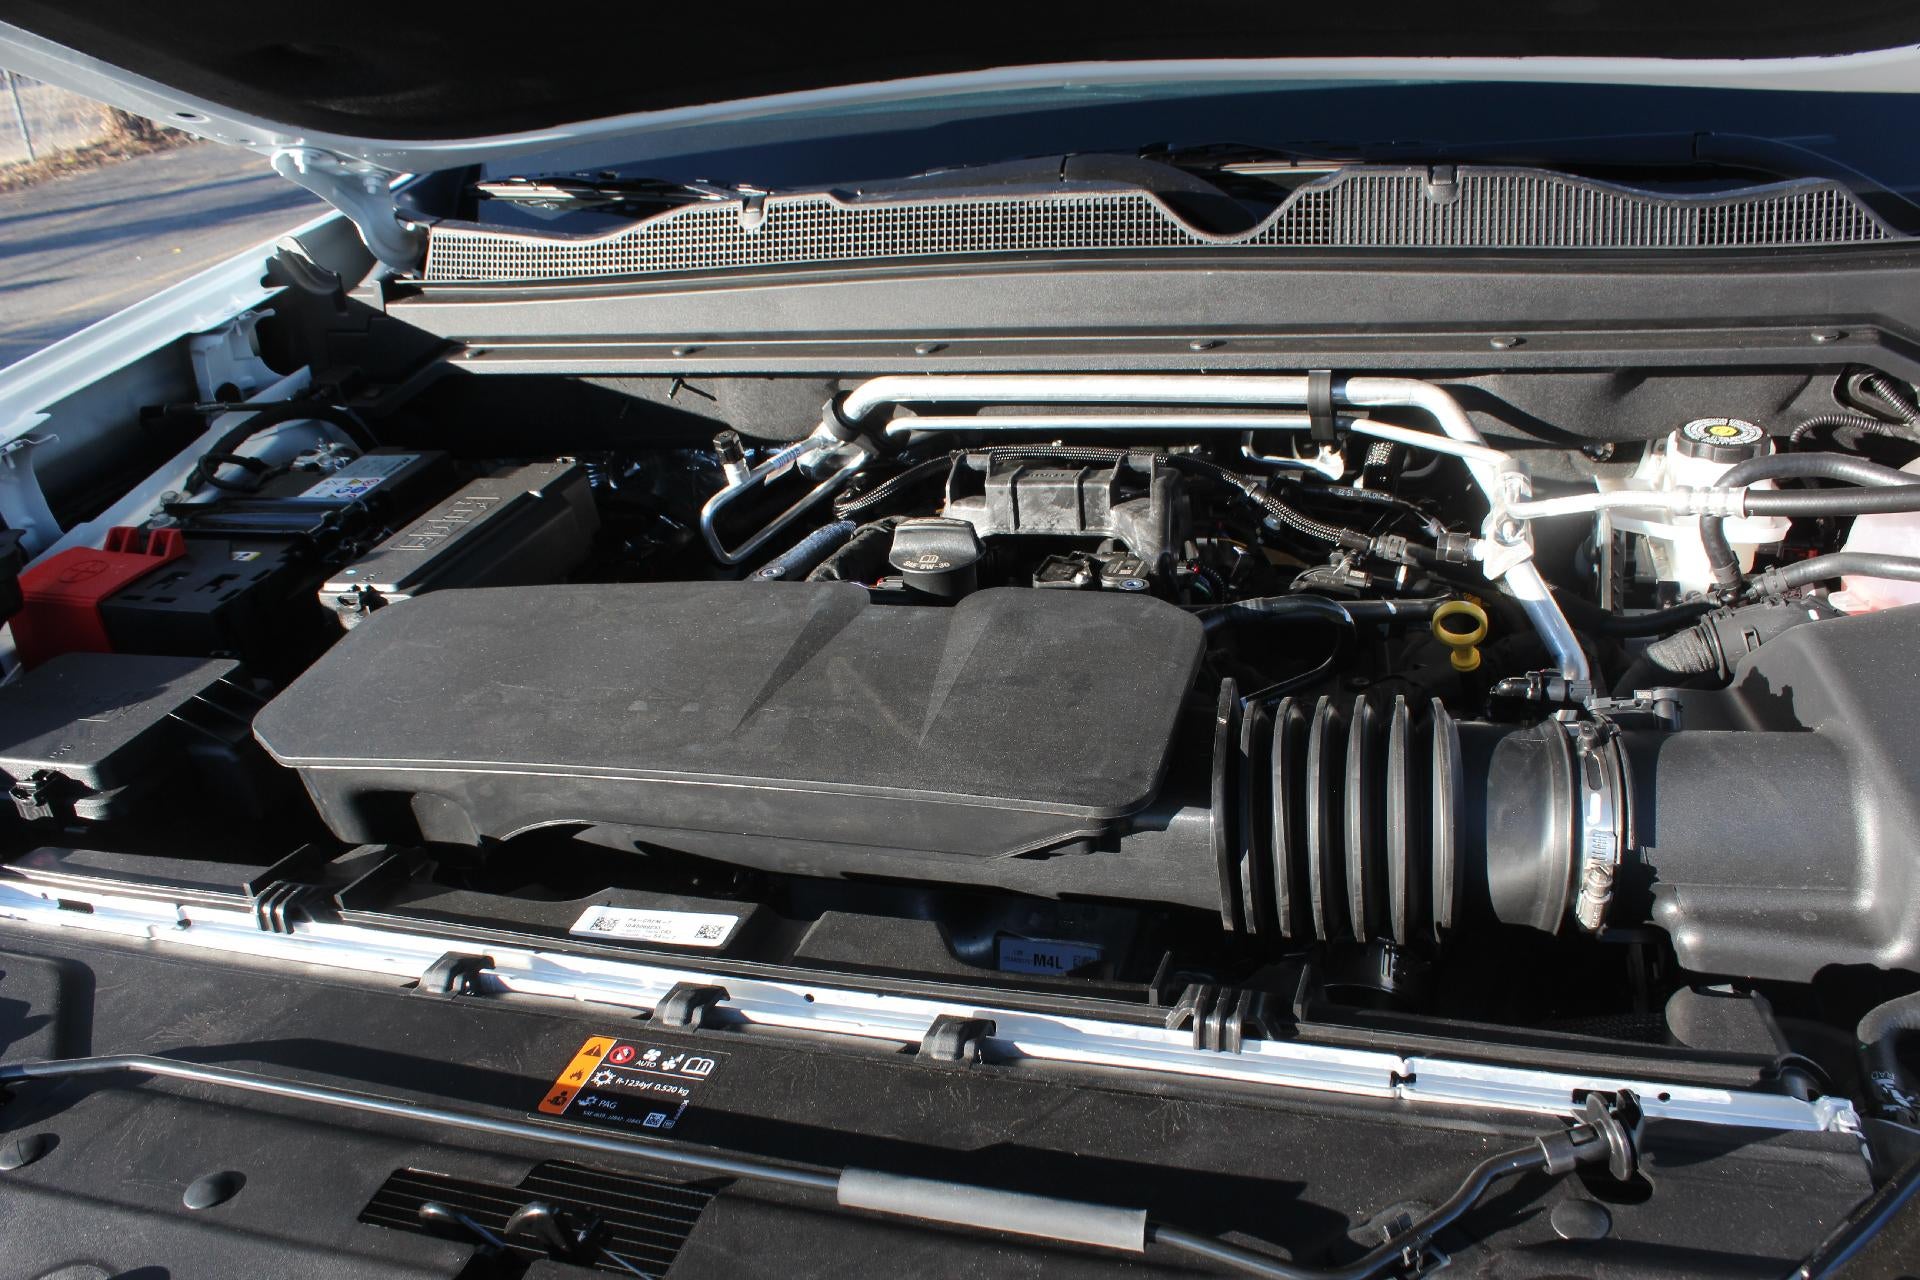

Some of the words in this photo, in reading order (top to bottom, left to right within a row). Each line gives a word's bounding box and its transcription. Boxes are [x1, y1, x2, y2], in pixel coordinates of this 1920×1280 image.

[1033, 953, 1064, 970] M4L
[635, 1060, 657, 1068] AUTO
[616, 1078, 653, 1089] R-1234yf
[654, 1084, 677, 1093] 0.520
[678, 1087, 689, 1096] kg
[598, 1100, 618, 1109] PAG
